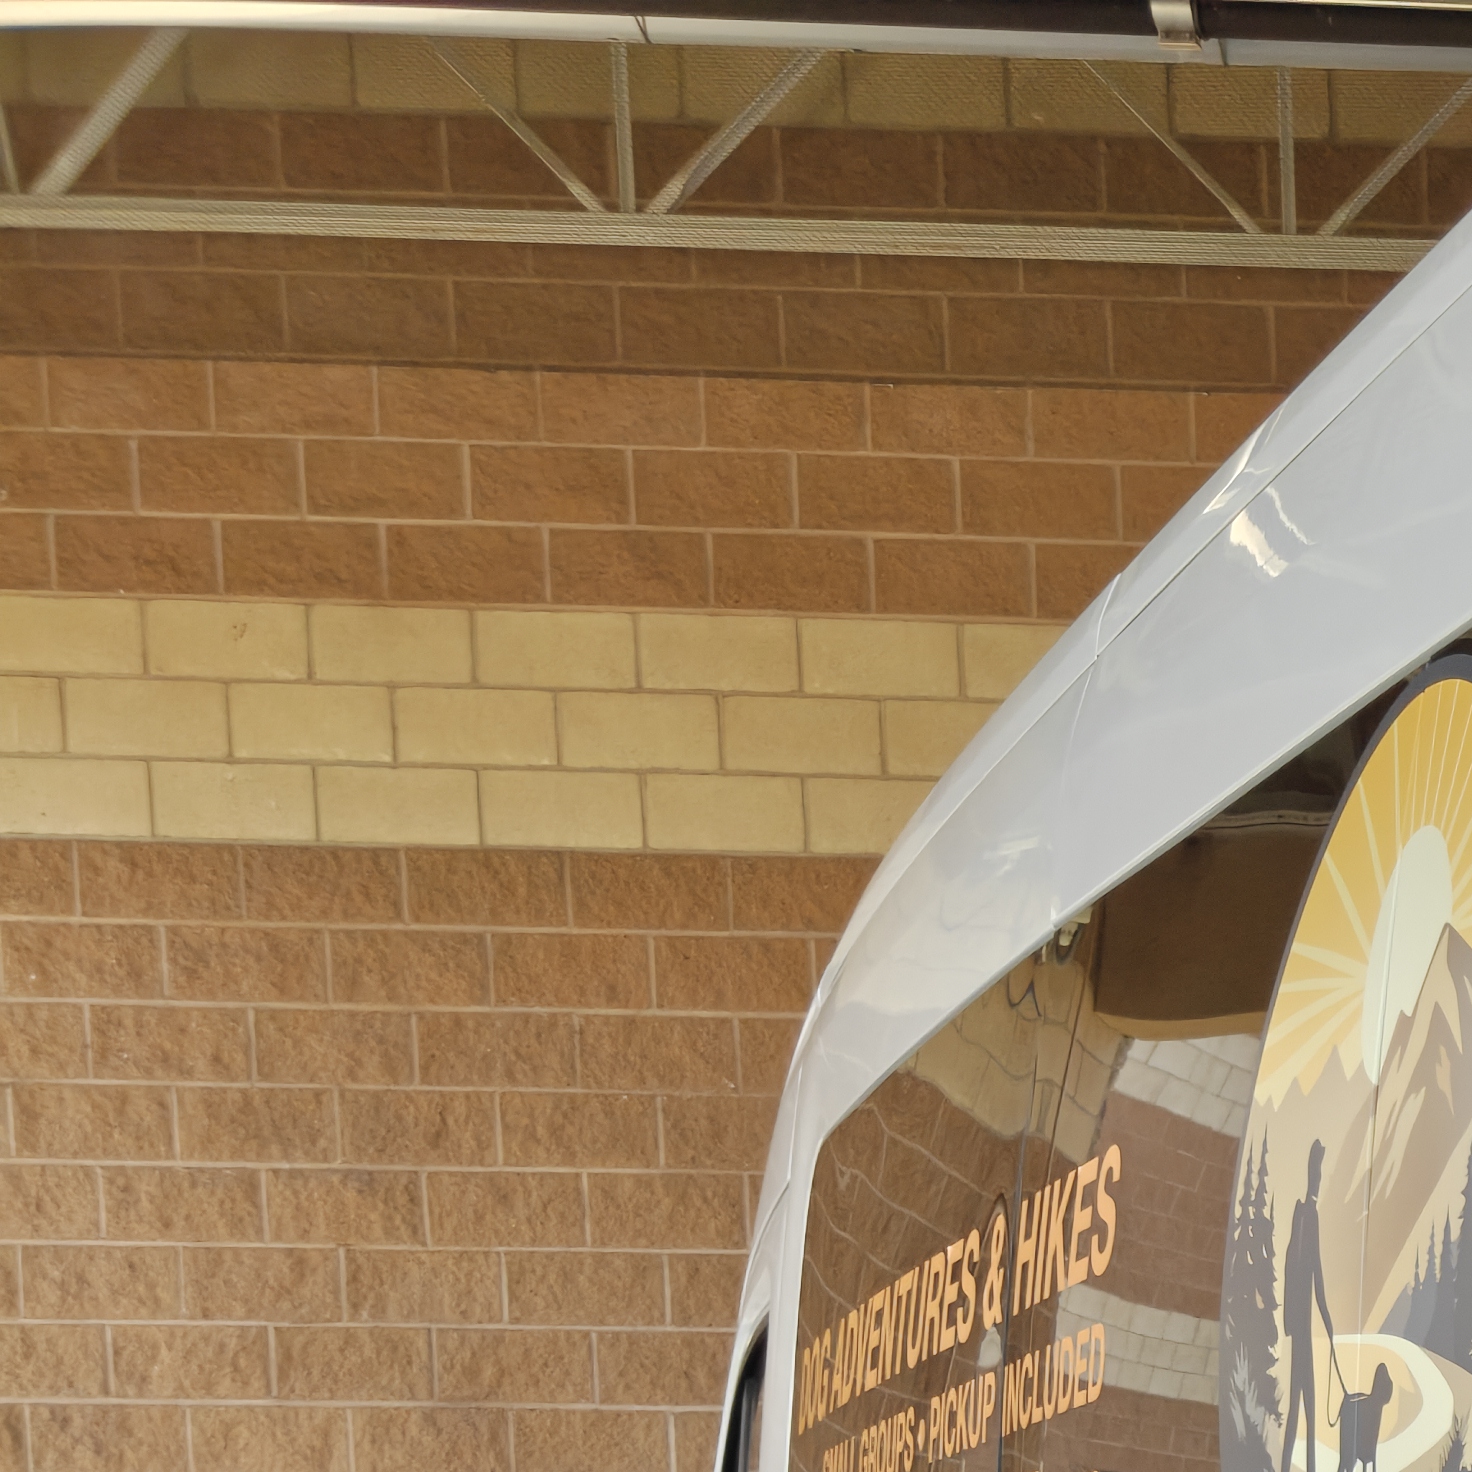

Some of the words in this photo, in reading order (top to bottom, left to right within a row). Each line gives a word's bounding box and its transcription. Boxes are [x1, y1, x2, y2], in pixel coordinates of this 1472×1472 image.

[798, 1327, 832, 1436] DOG
[829, 1228, 981, 1414] ADVENTURES
[982, 1213, 1006, 1331] &
[1013, 1143, 1122, 1317] HIKES
[928, 1371, 997, 1464] PICKUP
[1002, 1322, 1106, 1438] INCLUDED
